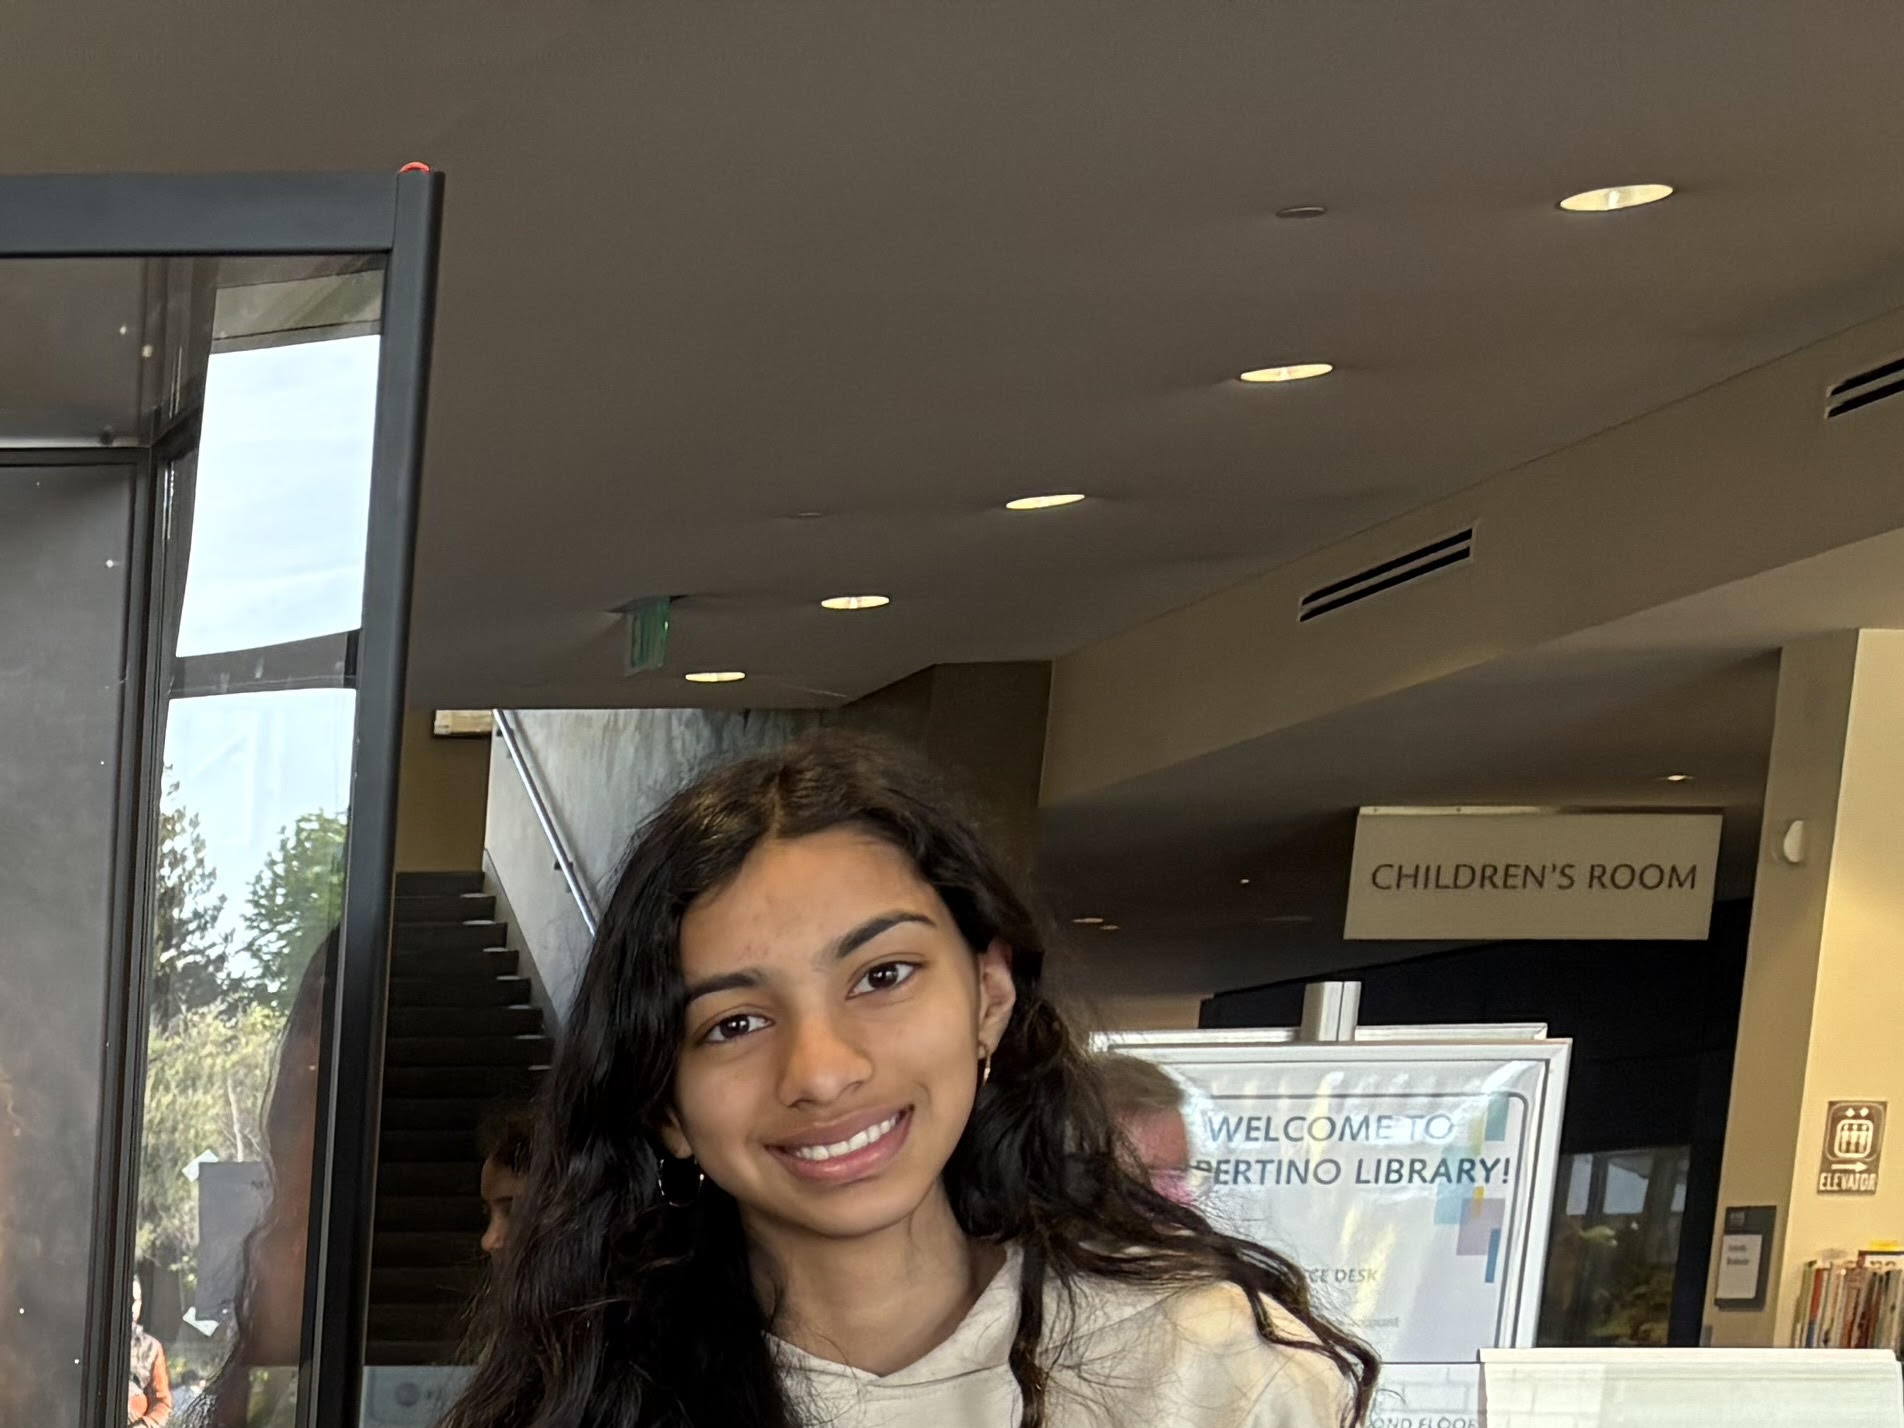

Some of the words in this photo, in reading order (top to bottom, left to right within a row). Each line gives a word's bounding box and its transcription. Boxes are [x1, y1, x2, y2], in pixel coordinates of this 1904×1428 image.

[1371, 863, 1576, 890] CHILDREN'S
[1588, 863, 1697, 890] ROOM
[1206, 1115, 1394, 1142] WELCOME
[1409, 1114, 1454, 1142] TO
[1196, 1158, 1341, 1185] PERTINO
[1355, 1157, 1511, 1185] LIBRARY!
[1819, 1172, 1877, 1192] ELEVATOR
[1334, 1268, 1379, 1283] DESK
